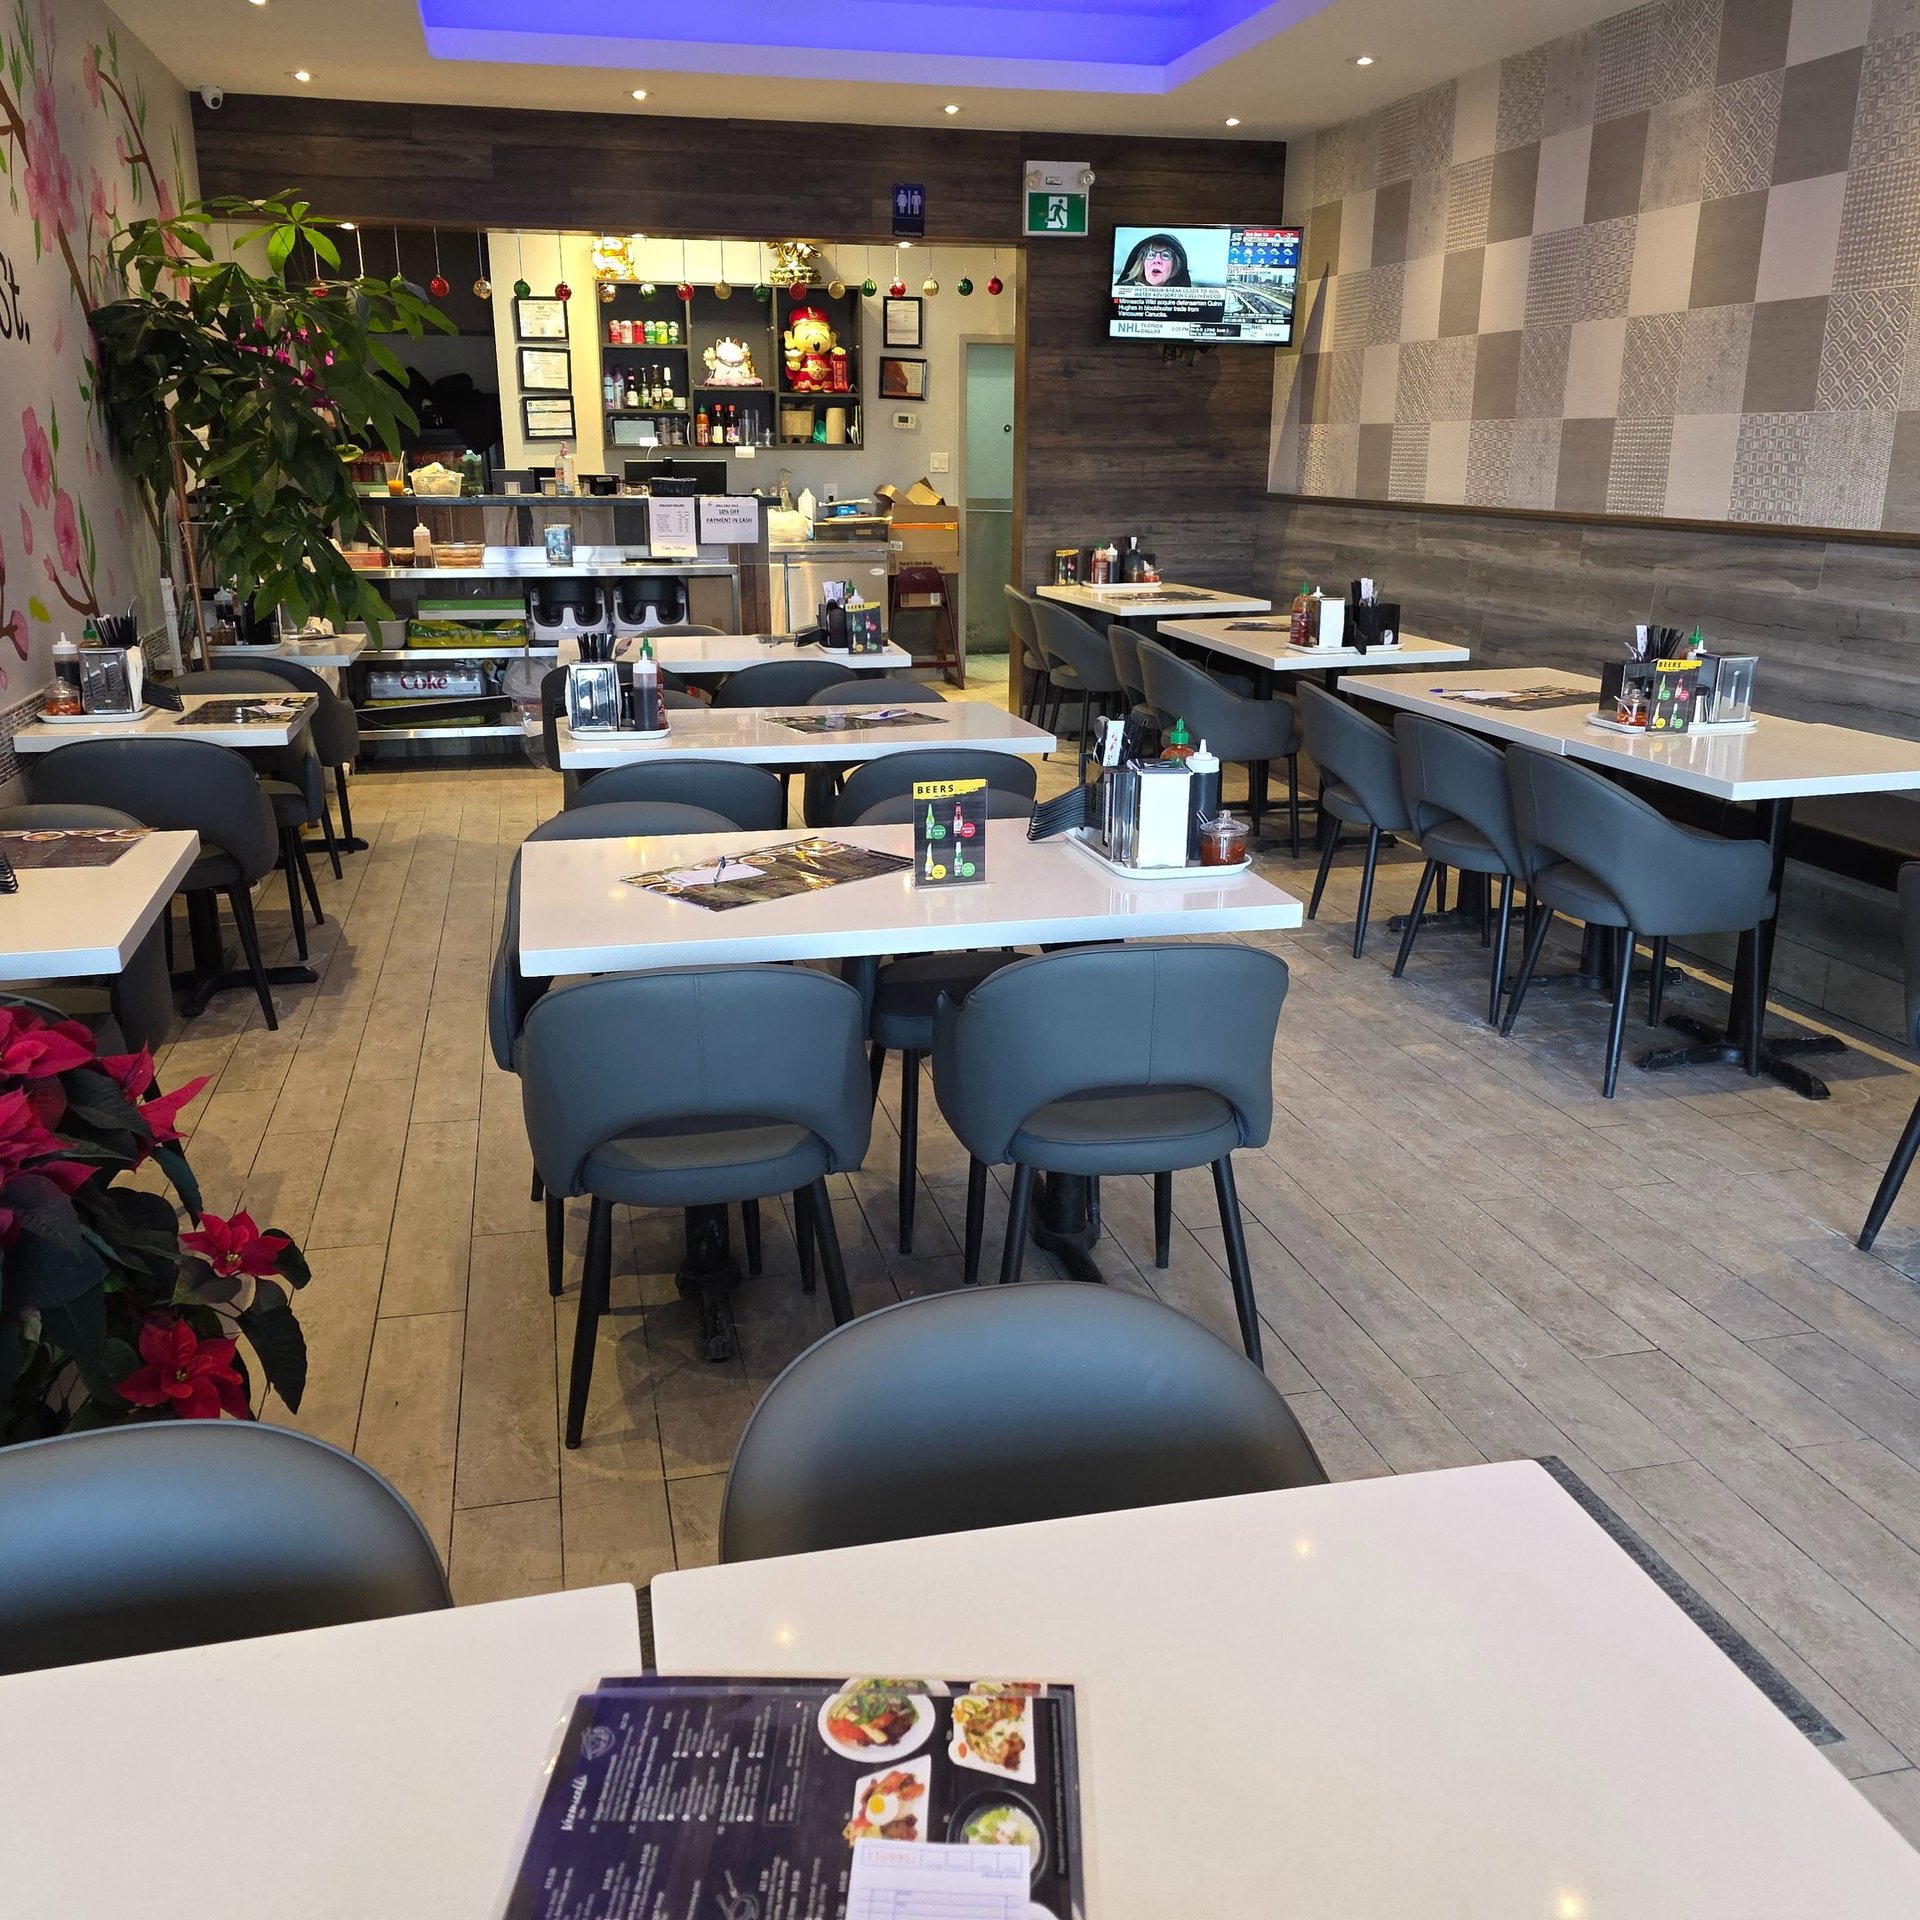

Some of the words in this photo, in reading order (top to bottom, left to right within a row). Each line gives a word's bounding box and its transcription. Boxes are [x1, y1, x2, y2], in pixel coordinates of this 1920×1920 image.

[1118, 322, 1140, 333] NHL
[400, 673, 449, 690] Coke
[917, 784, 954, 794] BEERS
